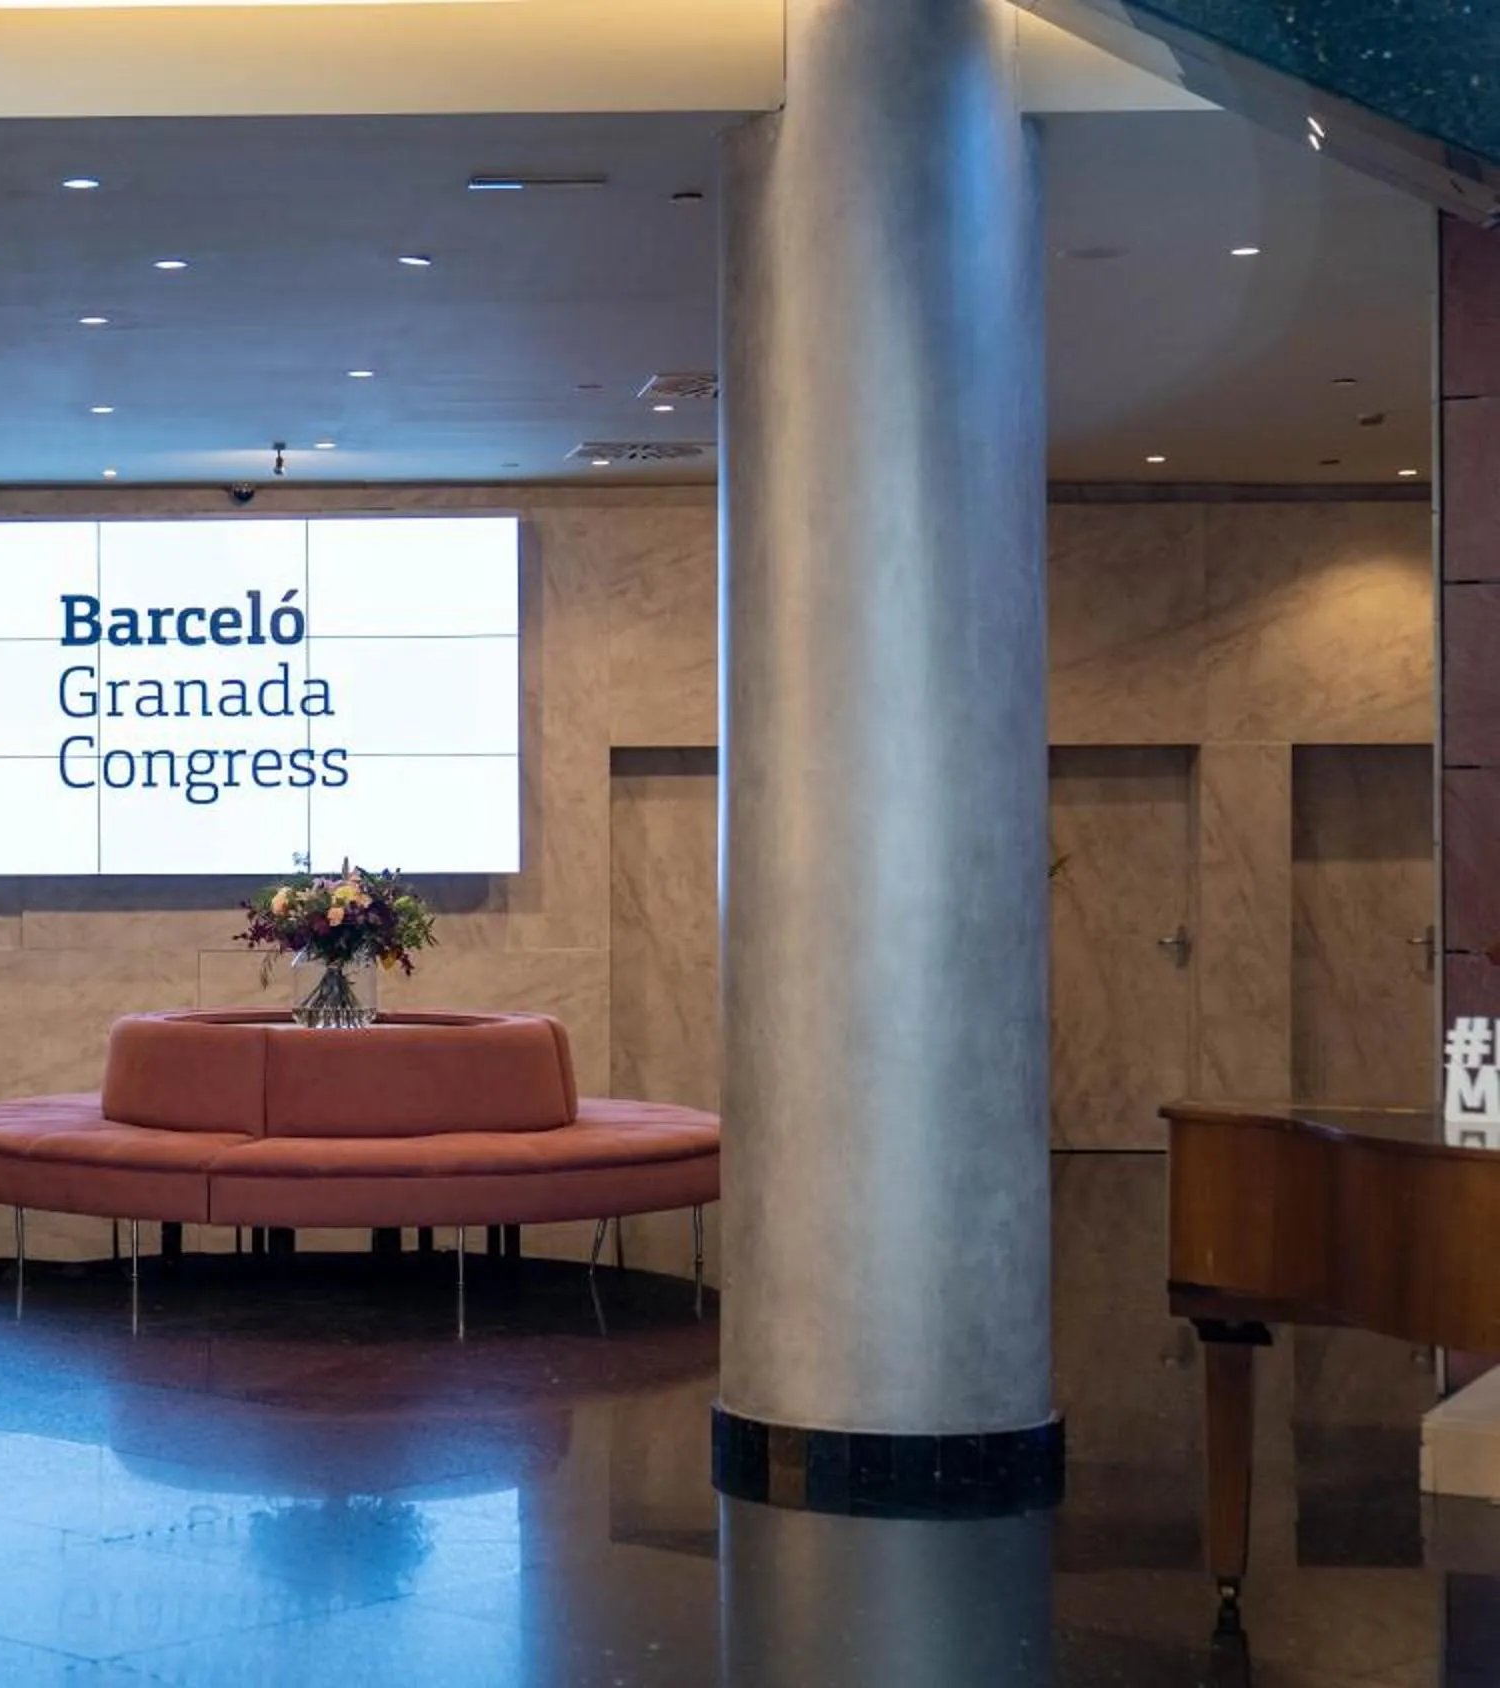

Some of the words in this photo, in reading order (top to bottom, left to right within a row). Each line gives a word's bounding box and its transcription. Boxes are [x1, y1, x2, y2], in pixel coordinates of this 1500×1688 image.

[60, 589, 305, 647] Barceló
[59, 662, 335, 718] Granada
[59, 735, 349, 805] Congress
